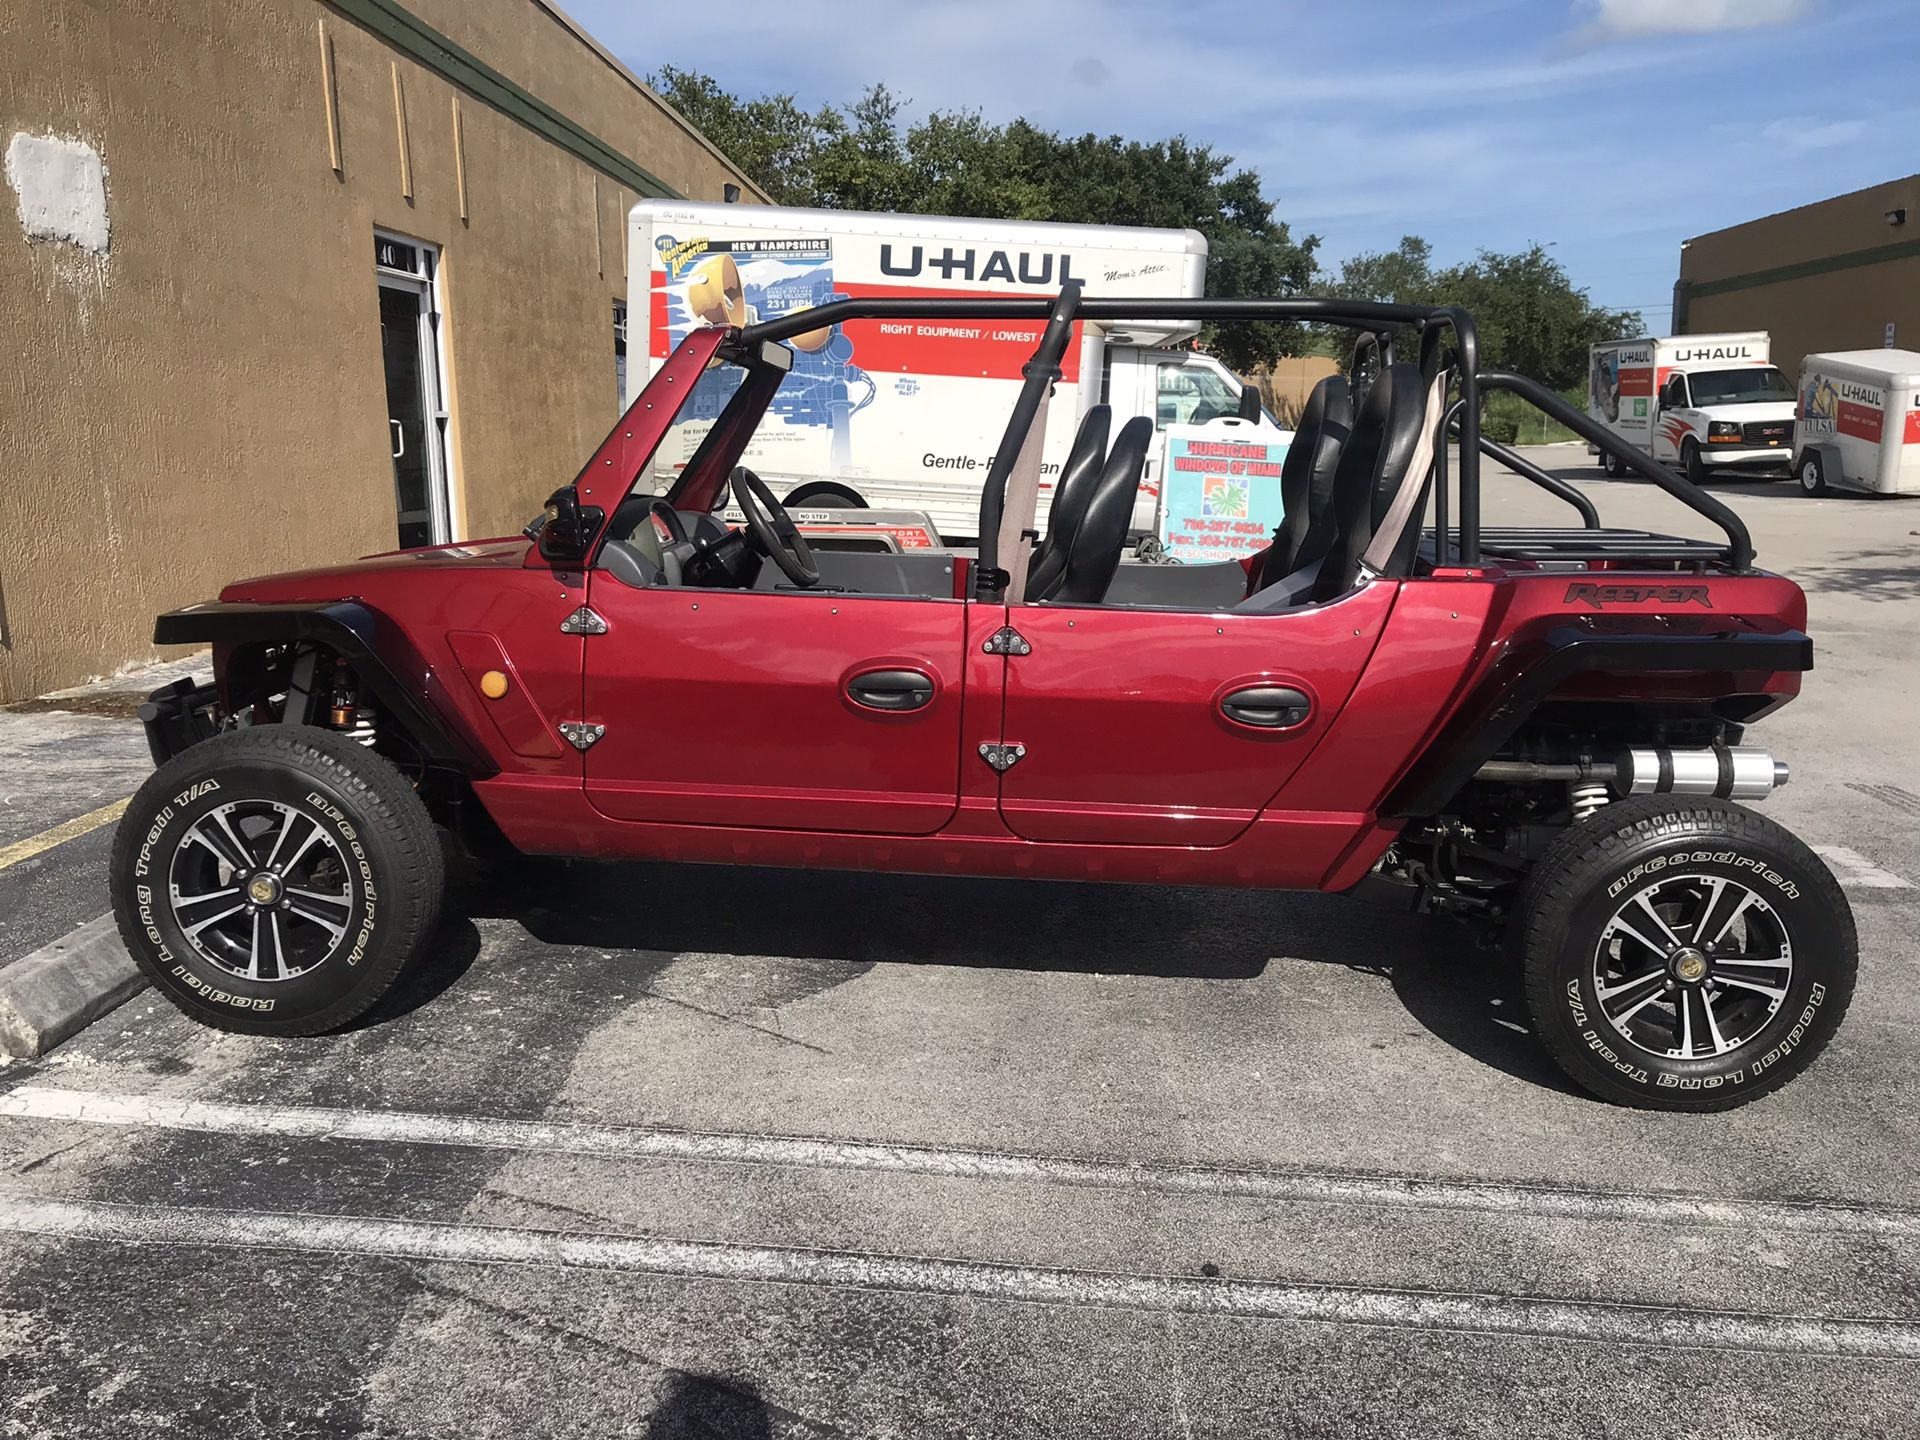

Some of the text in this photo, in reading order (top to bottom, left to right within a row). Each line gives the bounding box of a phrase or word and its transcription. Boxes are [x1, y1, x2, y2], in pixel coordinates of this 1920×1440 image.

[380, 244, 396, 265] 40
[731, 240, 827, 251] NEW HAMPSHIRE
[672, 242, 709, 280] America
[880, 244, 1086, 287] U-HAUL
[1104, 264, 1165, 281] Mom's Attic
[767, 299, 813, 309] 231 MPH
[881, 324, 913, 335] RIGHT
[917, 325, 981, 339] EQUIPMENT
[993, 331, 1037, 342] LOWEST
[1620, 350, 1650, 364] U-HAUL
[1676, 346, 1751, 361] U-HAUL
[1842, 383, 1881, 406] U-HAUL
[1188, 440, 1268, 460] HURRICANE
[1040, 463, 1059, 474] an
[1174, 456, 1281, 478] WINDOWS OF MIAMI
[1173, 548, 1200, 558] ALSO
[1204, 550, 1231, 560] SHOP
[1563, 583, 1713, 609] REEPER
[306, 792, 377, 967] BFGoodrich
[1607, 850, 1800, 899] BFGoodrich
[135, 779, 275, 1012] Radial Long Trail T/A
[1567, 979, 1826, 1089] Radial Long Trail T/A
